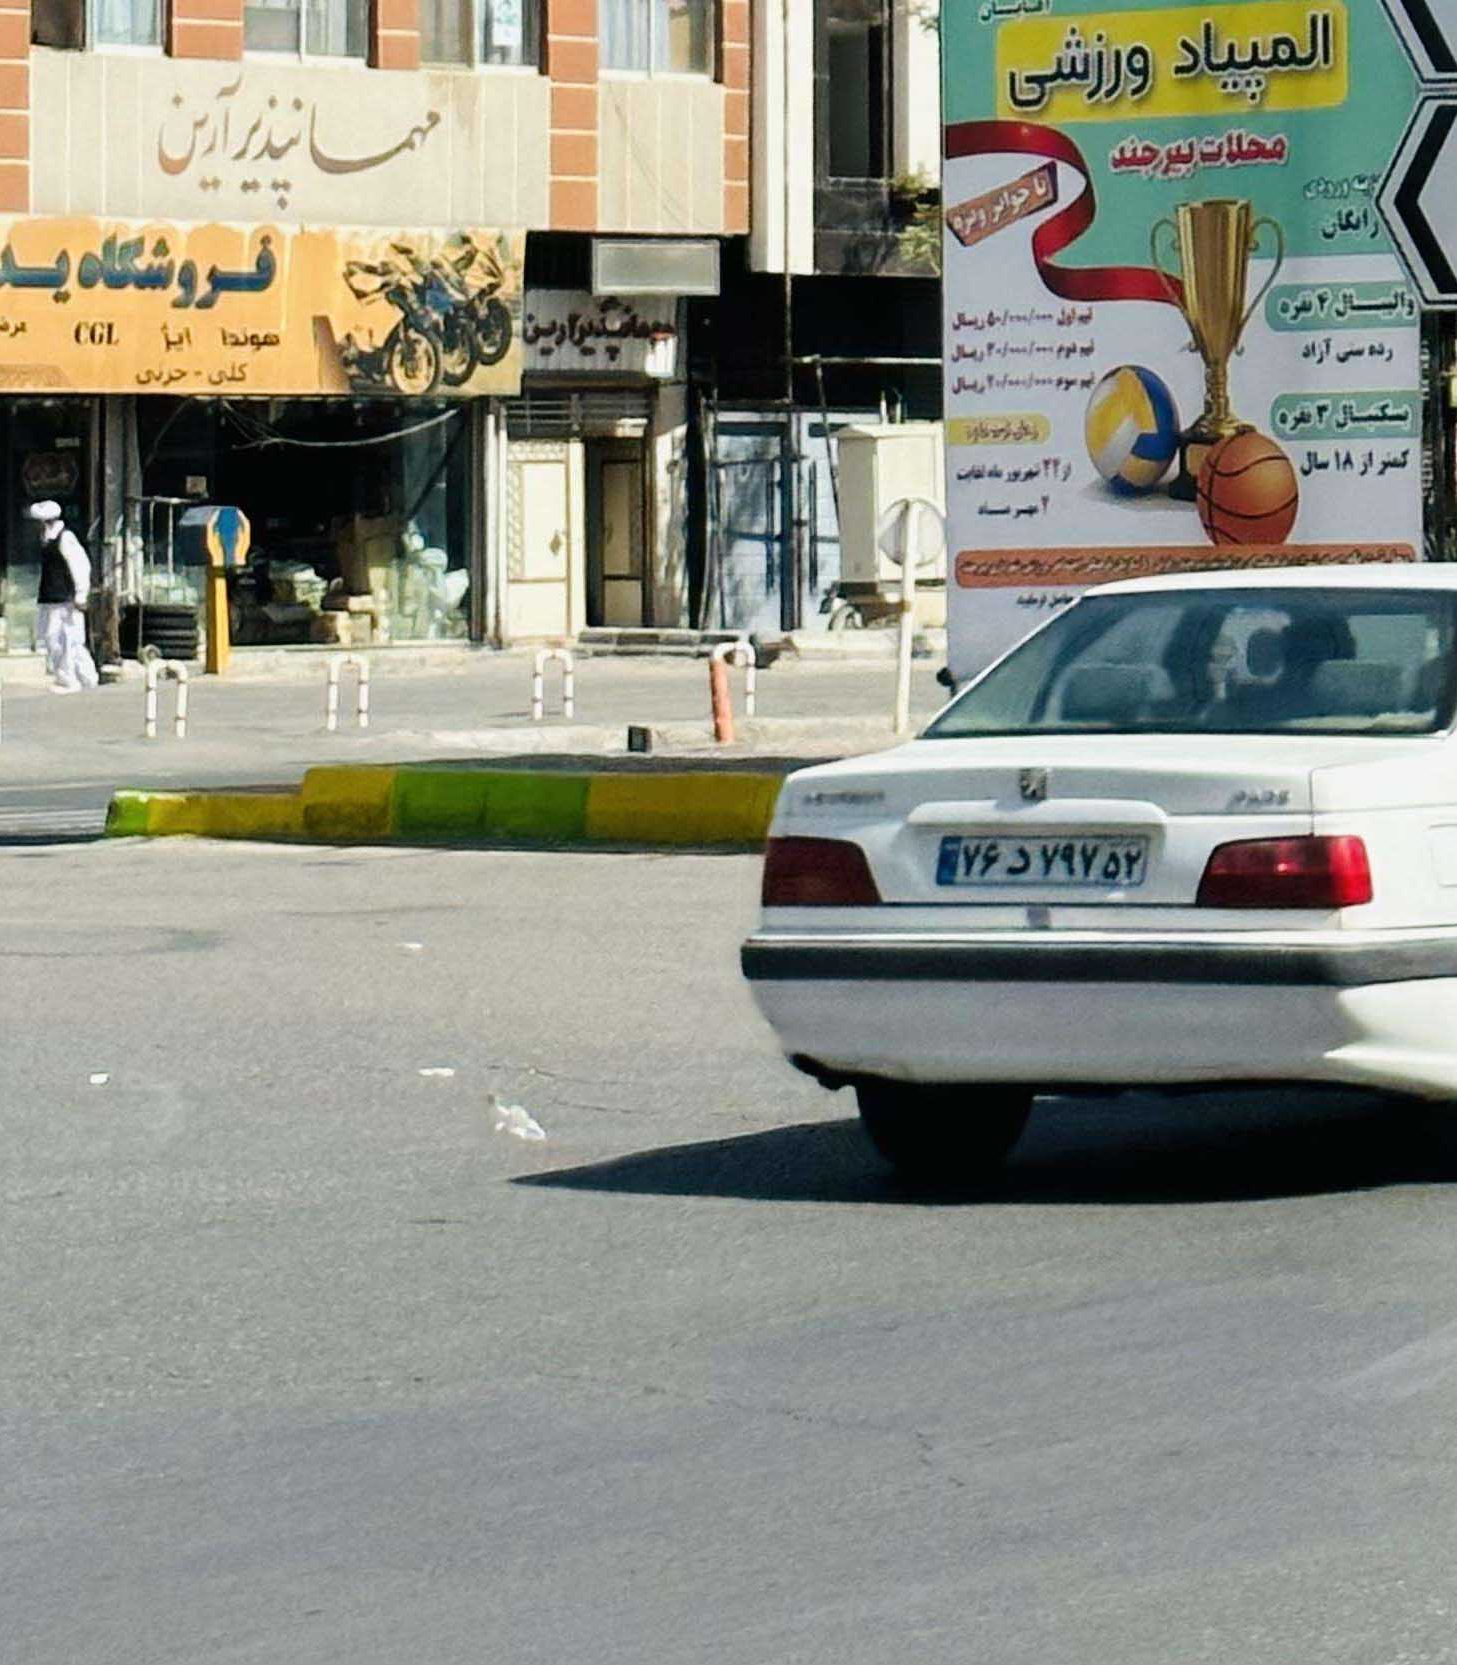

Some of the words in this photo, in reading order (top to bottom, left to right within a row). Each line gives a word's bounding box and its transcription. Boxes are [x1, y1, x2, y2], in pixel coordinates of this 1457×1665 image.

[1008, 26, 1151, 110] ورزشی
[1171, 11, 1331, 100] المپیاد
[1109, 140, 1195, 182] بیرجند
[1197, 131, 1288, 166] محلات
[78, 234, 276, 309] فروشگاه
[220, 326, 281, 351] هوندا
